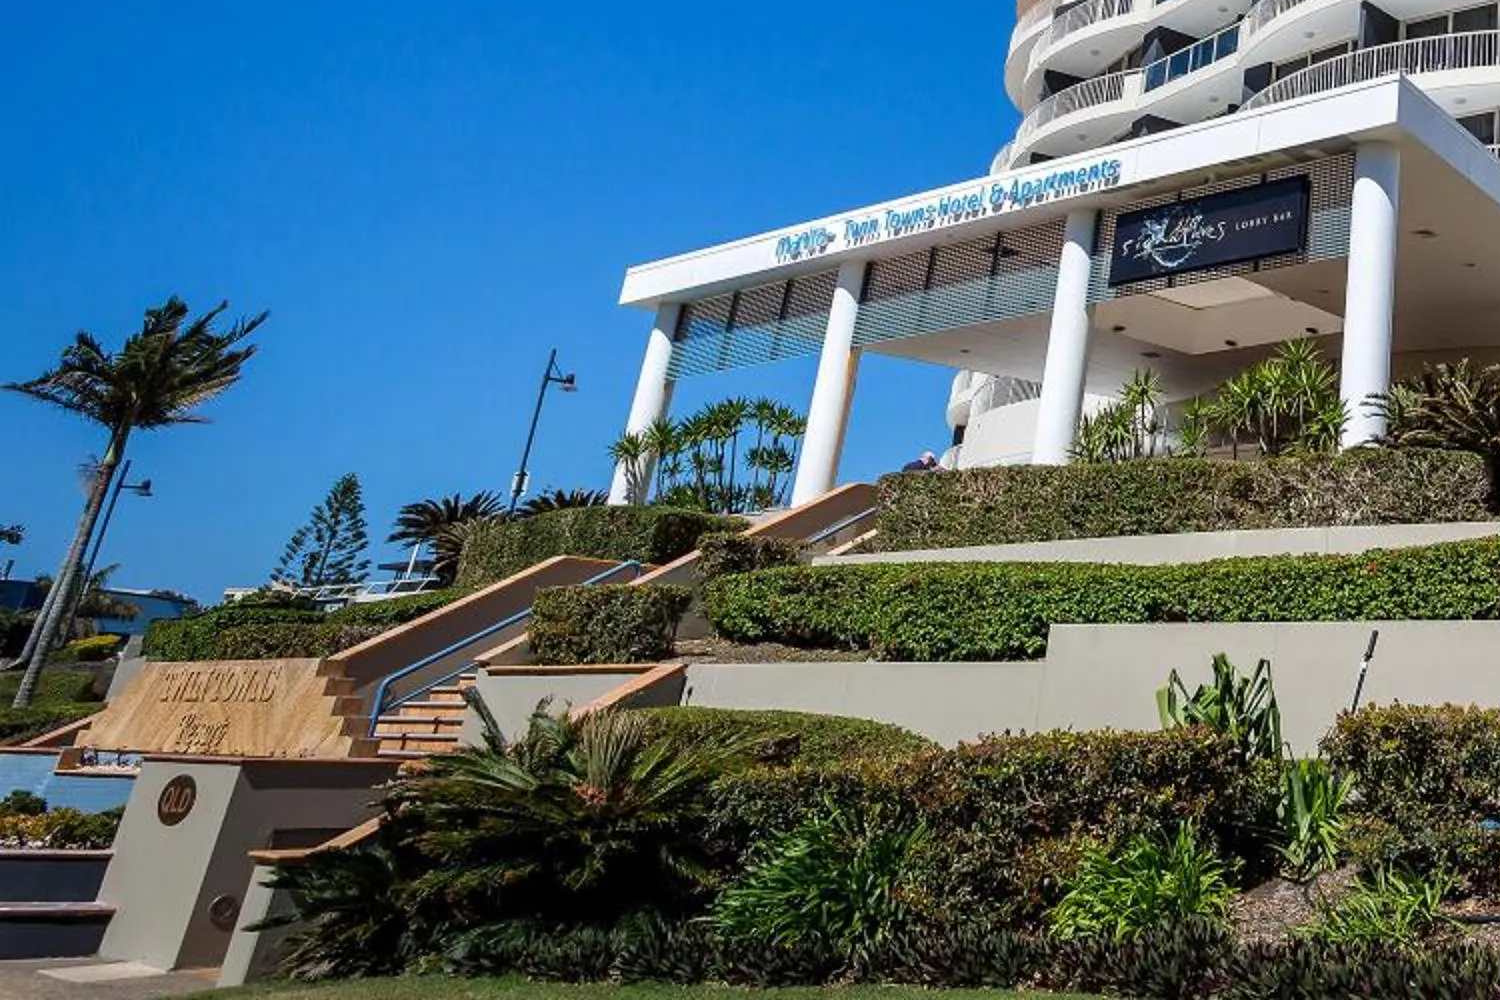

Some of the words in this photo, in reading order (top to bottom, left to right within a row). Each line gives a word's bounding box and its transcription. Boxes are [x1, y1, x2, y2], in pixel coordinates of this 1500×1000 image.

[844, 218, 879, 241] Twin
[885, 206, 935, 231] Towns
[938, 187, 984, 217] Hotel
[992, 183, 1007, 207] &
[1010, 159, 1121, 209] Apartments
[161, 787, 192, 813] QLD
